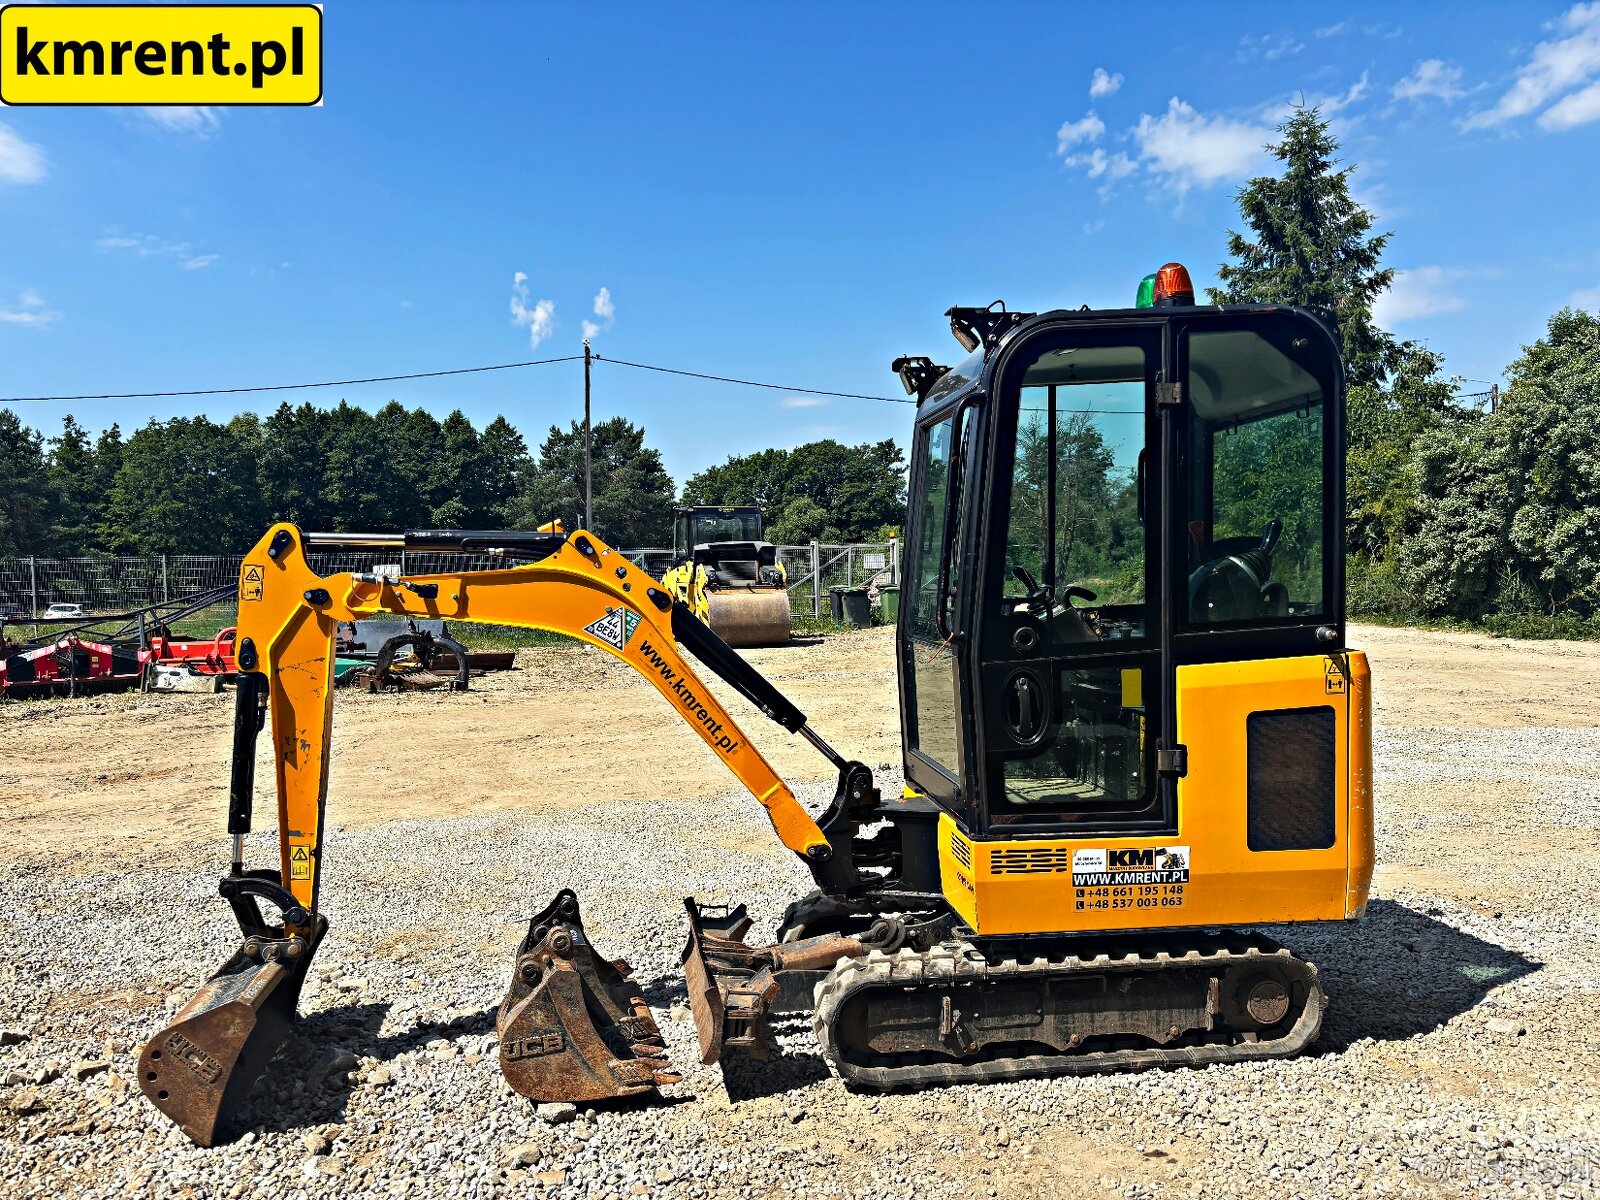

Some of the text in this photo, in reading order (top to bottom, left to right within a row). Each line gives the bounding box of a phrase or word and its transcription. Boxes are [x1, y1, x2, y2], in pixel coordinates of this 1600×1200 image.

[596, 622, 621, 641] BE8W
[607, 617, 620, 629] 44
[639, 639, 739, 754] www.kmrent.pl
[1109, 849, 1154, 866] KM
[1073, 871, 1188, 886] WWW.KMRENT.PL
[1087, 885, 1184, 897] +48 661 195 148
[1087, 897, 1183, 909] +48 537 003 063
[502, 1032, 567, 1062] JCB
[165, 1031, 223, 1084] JCB
